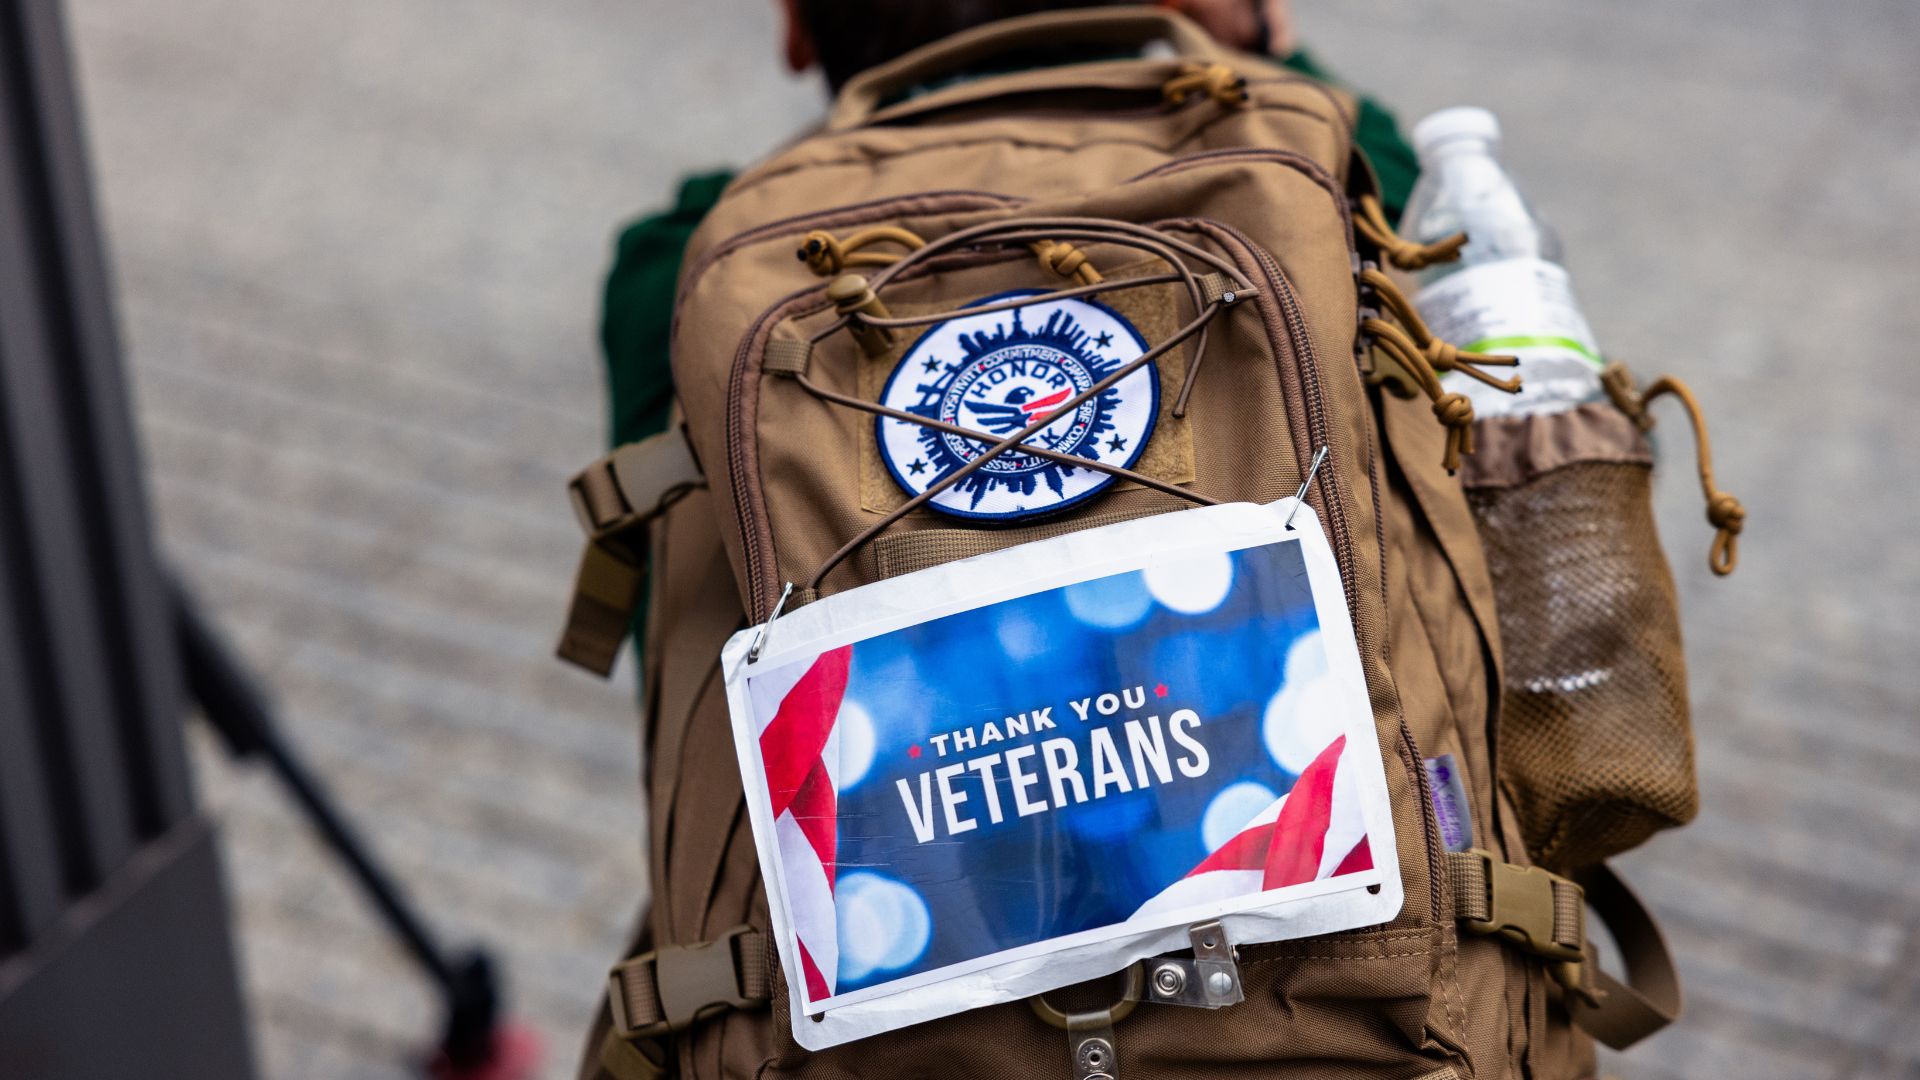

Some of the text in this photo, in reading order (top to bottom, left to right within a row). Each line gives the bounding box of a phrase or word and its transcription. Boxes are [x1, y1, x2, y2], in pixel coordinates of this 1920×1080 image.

[970, 359, 1066, 398] HONOR
[984, 348, 1060, 366] COMMITMENT
[944, 363, 980, 418] POSITIVITY
[1062, 358, 1093, 423] CAMARERIE
[967, 451, 1017, 470] PASSN
[1021, 426, 1084, 467] COMMITY
[930, 685, 1146, 757] THANK YOU
[896, 708, 1210, 844] VETERANS
